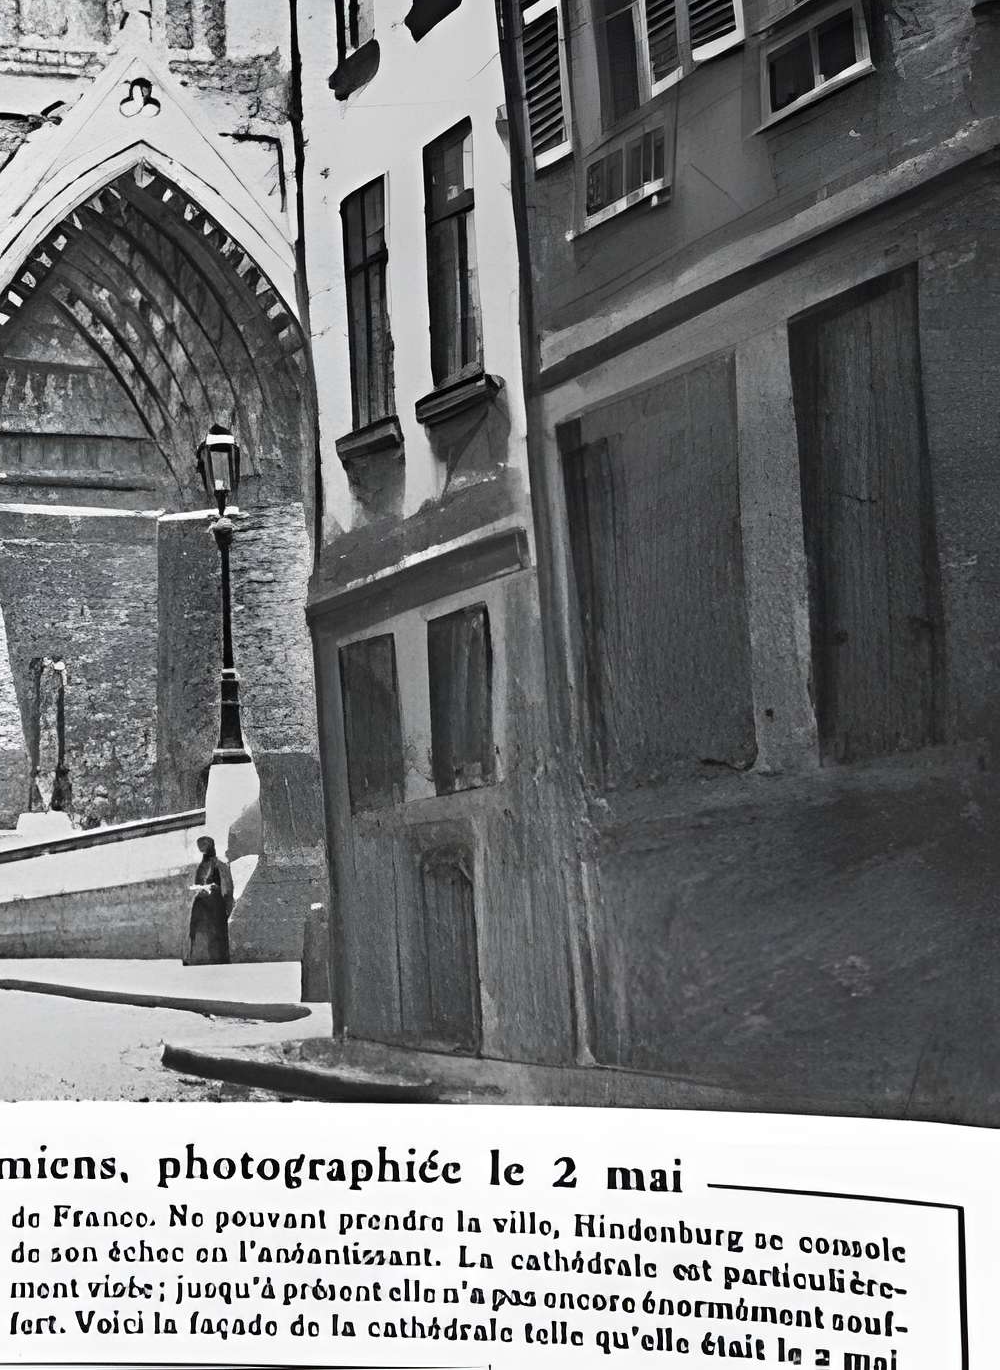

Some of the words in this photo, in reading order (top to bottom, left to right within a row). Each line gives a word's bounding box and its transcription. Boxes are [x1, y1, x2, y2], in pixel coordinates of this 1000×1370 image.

[157, 1143, 462, 1191] photographiée
[489, 1149, 524, 1186] le
[552, 1156, 578, 1189] 2
[607, 1158, 683, 1193] mai
